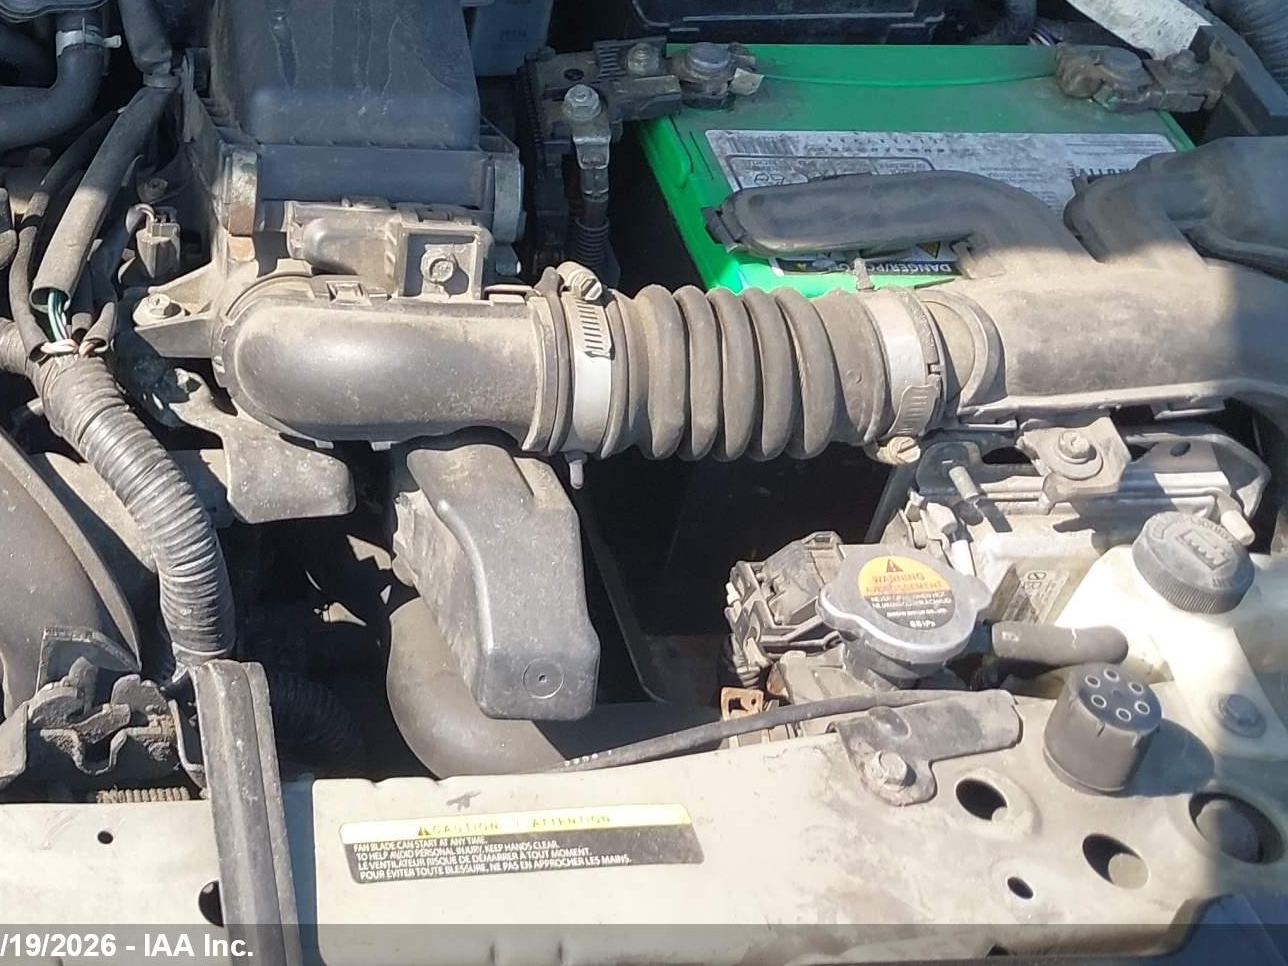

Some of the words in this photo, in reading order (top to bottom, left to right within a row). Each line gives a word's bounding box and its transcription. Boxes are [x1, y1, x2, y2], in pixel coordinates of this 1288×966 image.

[353, 843, 370, 853] FAN
[370, 841, 395, 852] BLADE
[397, 840, 414, 850] CAN
[415, 838, 437, 848] START
[439, 837, 448, 846] AT
[450, 836, 468, 846] ANY
[468, 834, 488, 845] TIME.
[356, 852, 368, 862] TO
[369, 851, 389, 861] HELP
[390, 849, 414, 860] AVOID
[415, 846, 456, 858] PERSONAL
[484, 843, 503, 853] KEEP
[504, 842, 532, 852] HANDS
[533, 840, 560, 850] CLEAR.
[358, 862, 369, 871] LE
[369, 858, 425, 870] VENTILATEUR
[426, 856, 457, 866] RISQUE
[459, 854, 470, 864] DE
[526, 849, 550, 860] TOUT
[550, 846, 593, 858] MOMENT.
[360, 870, 385, 880] POUR
[415, 866, 444, 876] TOUTE
[489, 862, 502, 872] NE
[502, 860, 520, 871] PAS
[520, 860, 532, 870] EN
[534, 857, 585, 869] APPROCHER
[585, 856, 600, 866] LES
[601, 854, 632, 865] MAINS.
